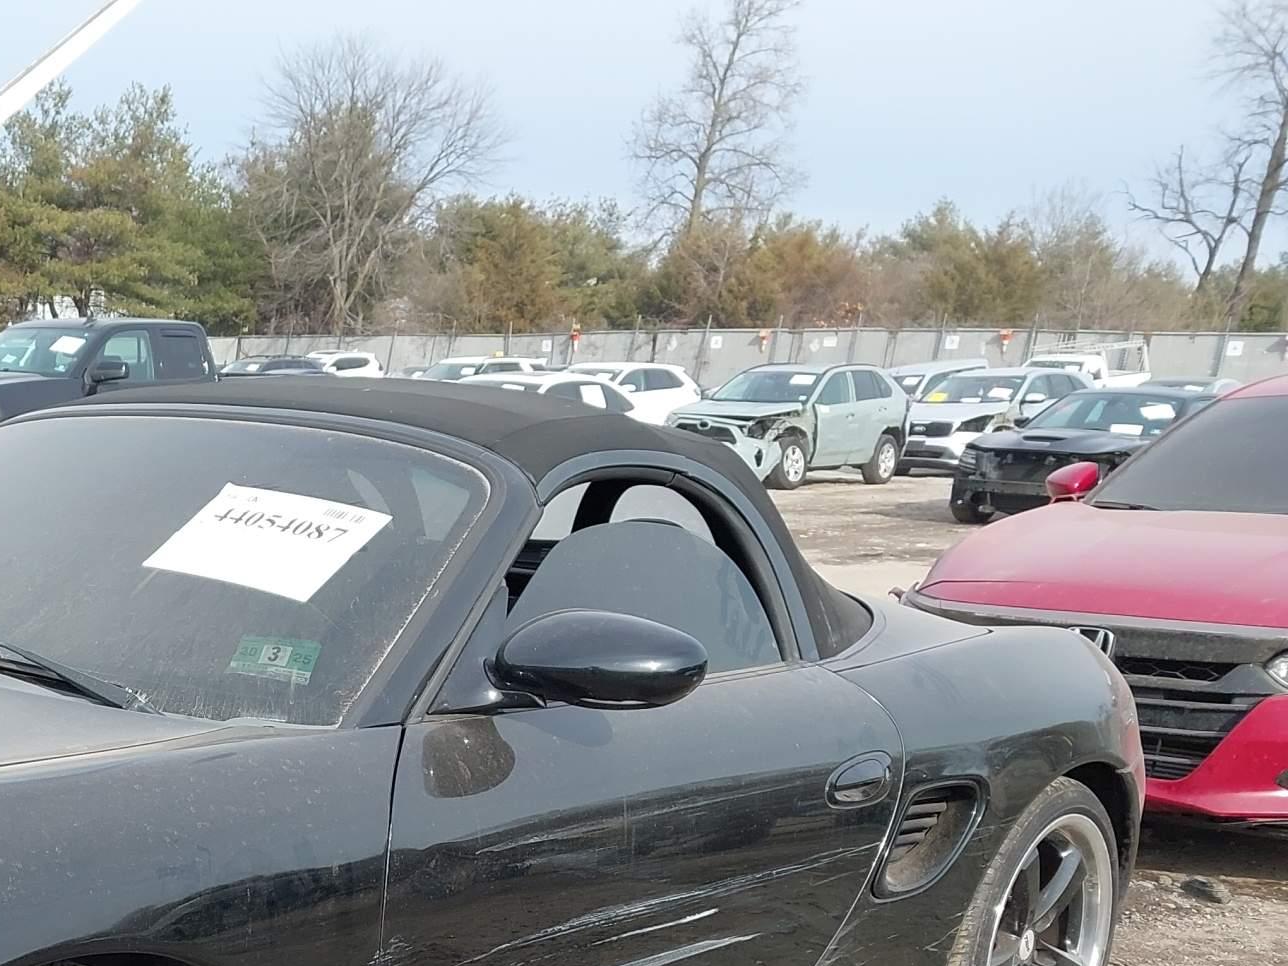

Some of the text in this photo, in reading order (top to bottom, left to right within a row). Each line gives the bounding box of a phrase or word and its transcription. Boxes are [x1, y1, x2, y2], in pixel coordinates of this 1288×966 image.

[214, 508, 349, 543] 44054087
[239, 646, 313, 665] 20 3 25
